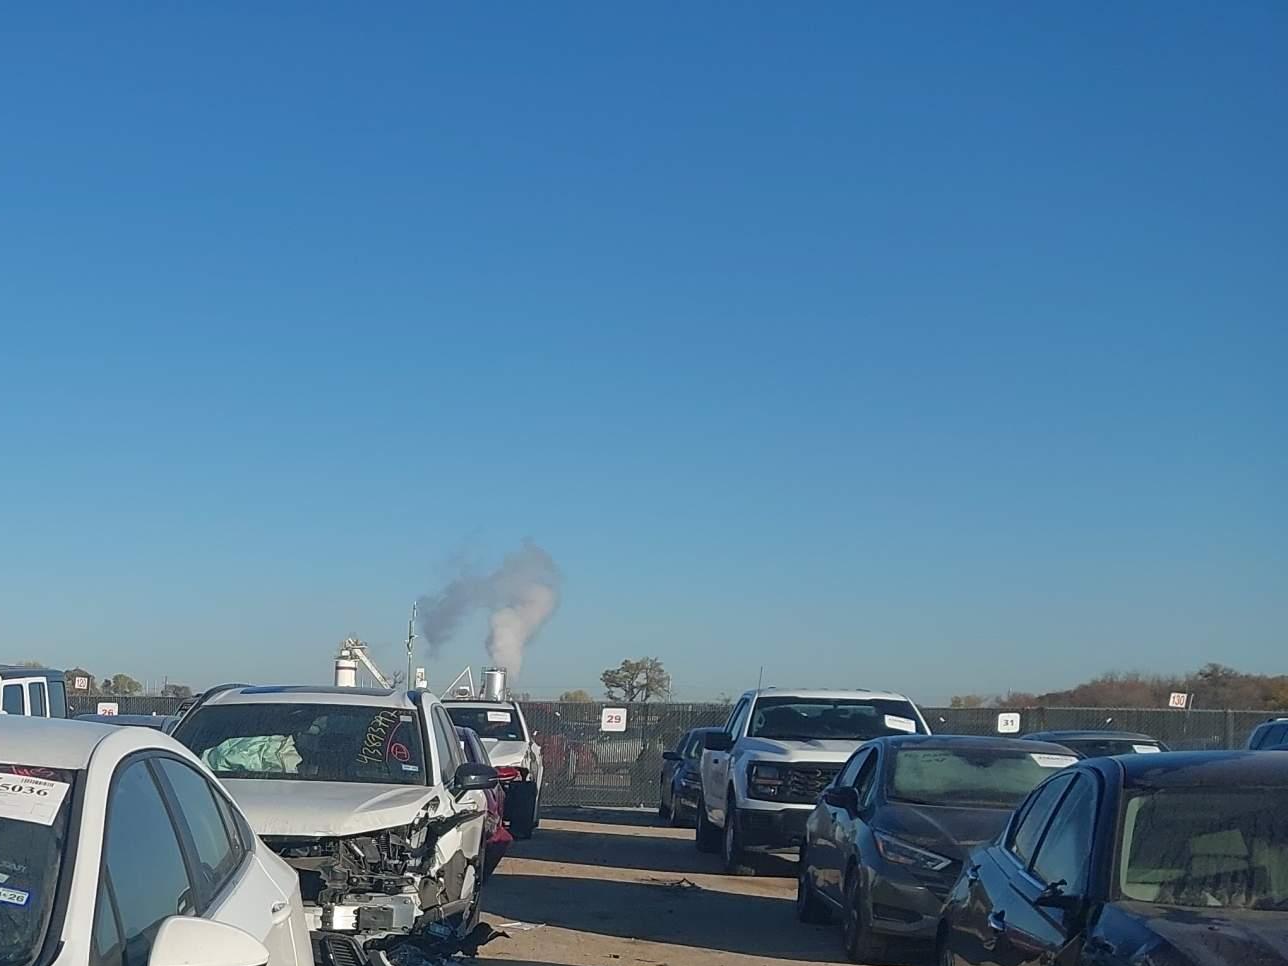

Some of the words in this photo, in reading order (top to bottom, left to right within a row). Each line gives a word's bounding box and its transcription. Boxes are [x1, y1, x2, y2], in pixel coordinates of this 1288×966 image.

[1172, 694, 1185, 706] 130
[606, 714, 622, 724] 29
[1002, 719, 1014, 727] 31
[8, 893, 25, 903] 26
